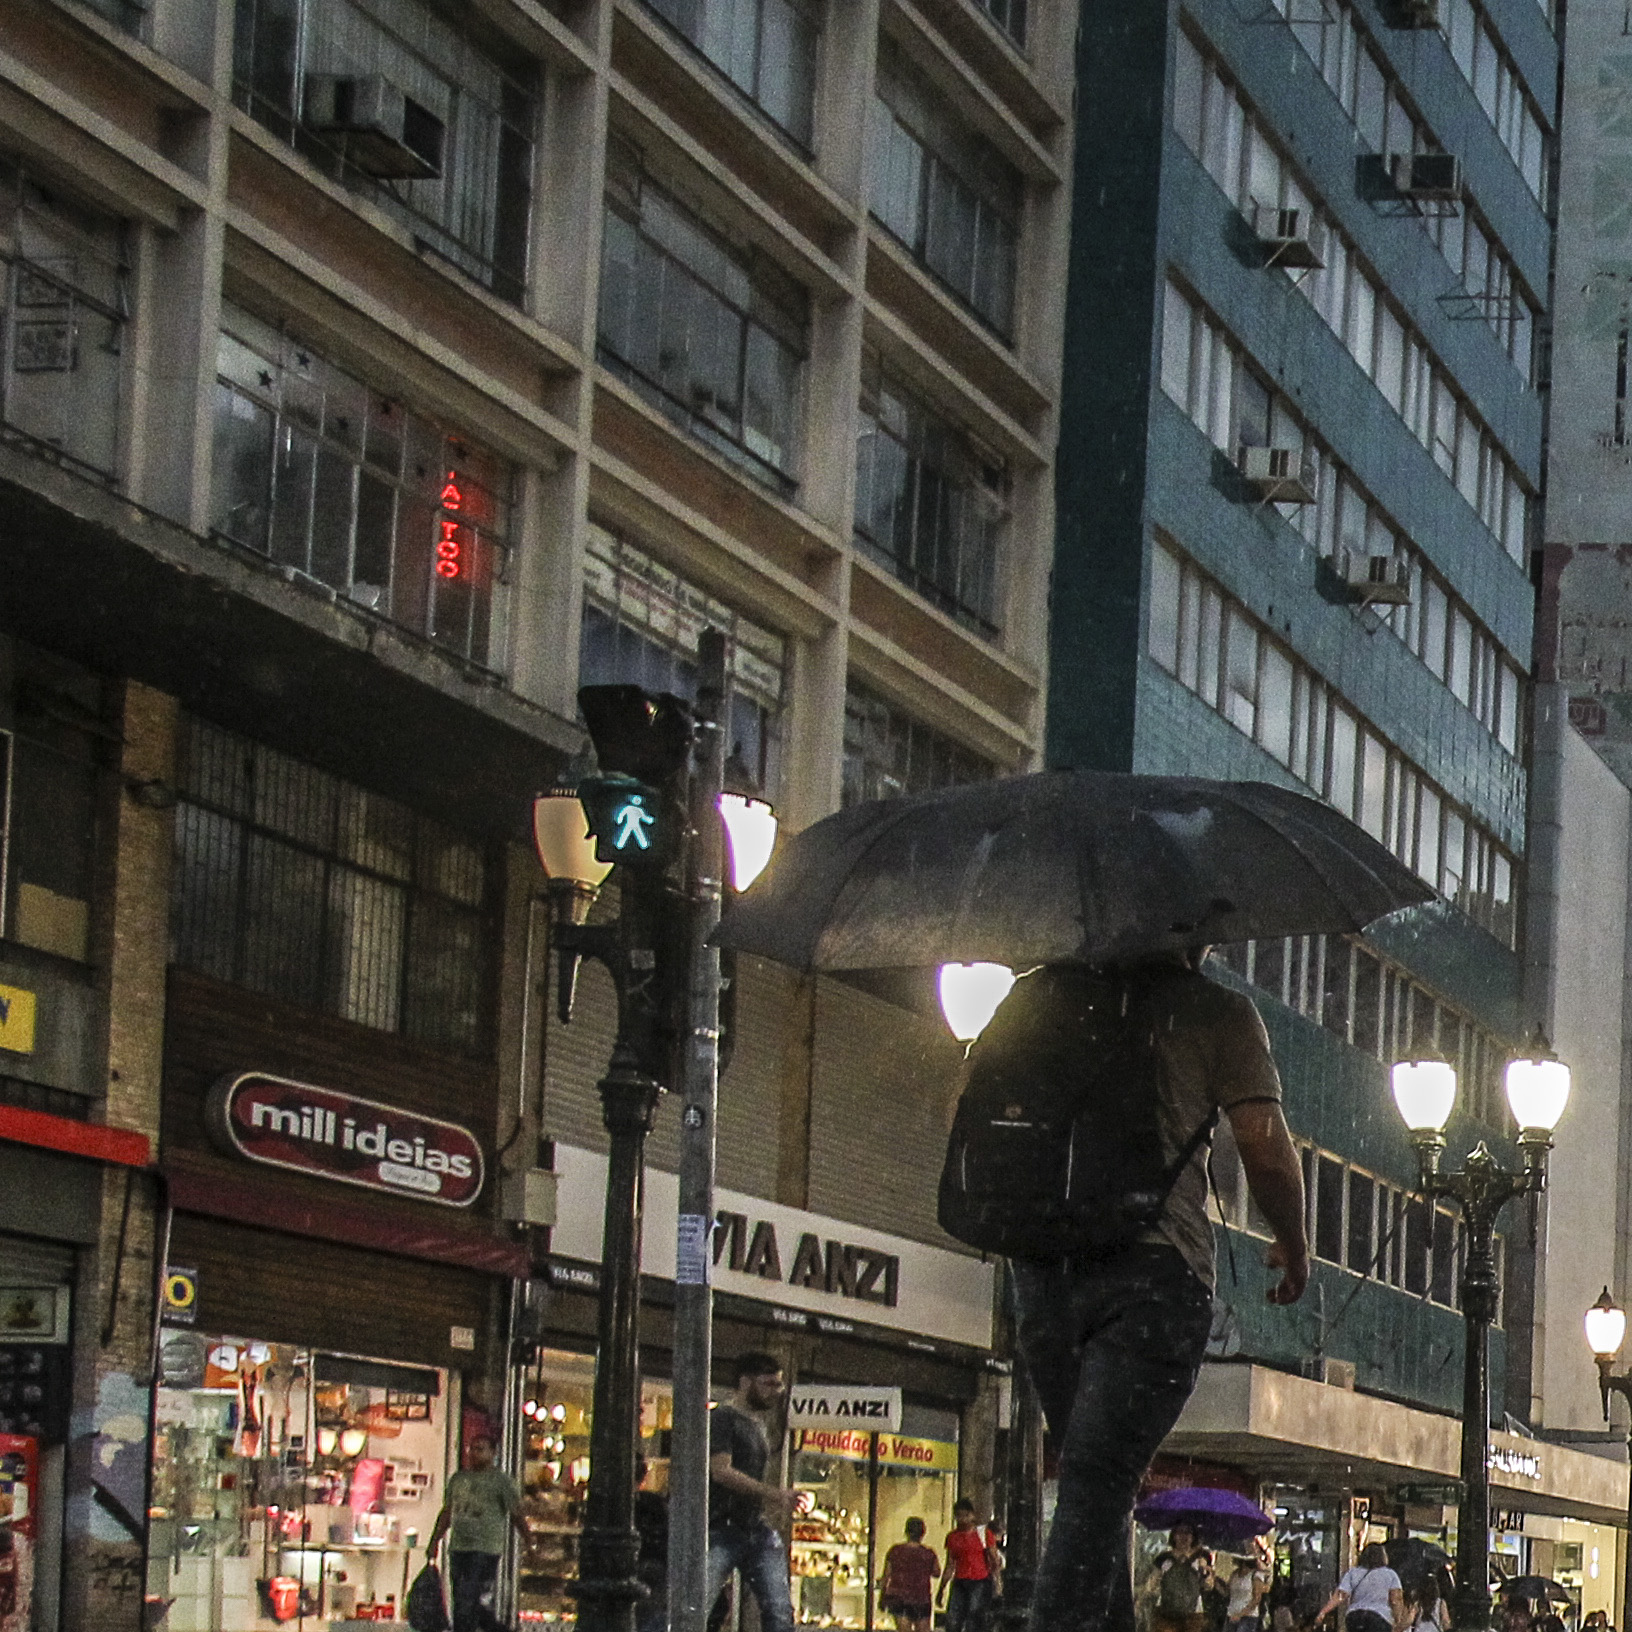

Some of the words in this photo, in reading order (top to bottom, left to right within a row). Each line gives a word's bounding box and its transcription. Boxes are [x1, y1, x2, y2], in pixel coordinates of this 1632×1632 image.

[436, 471, 462, 578] ATOO
[251, 1101, 337, 1146] mill
[342, 1117, 473, 1179] ideias
[789, 1232, 900, 1307] ANZI
[791, 1398, 830, 1416] VIA
[835, 1399, 890, 1418] ANZI
[803, 1429, 888, 1459] Liquidaço
